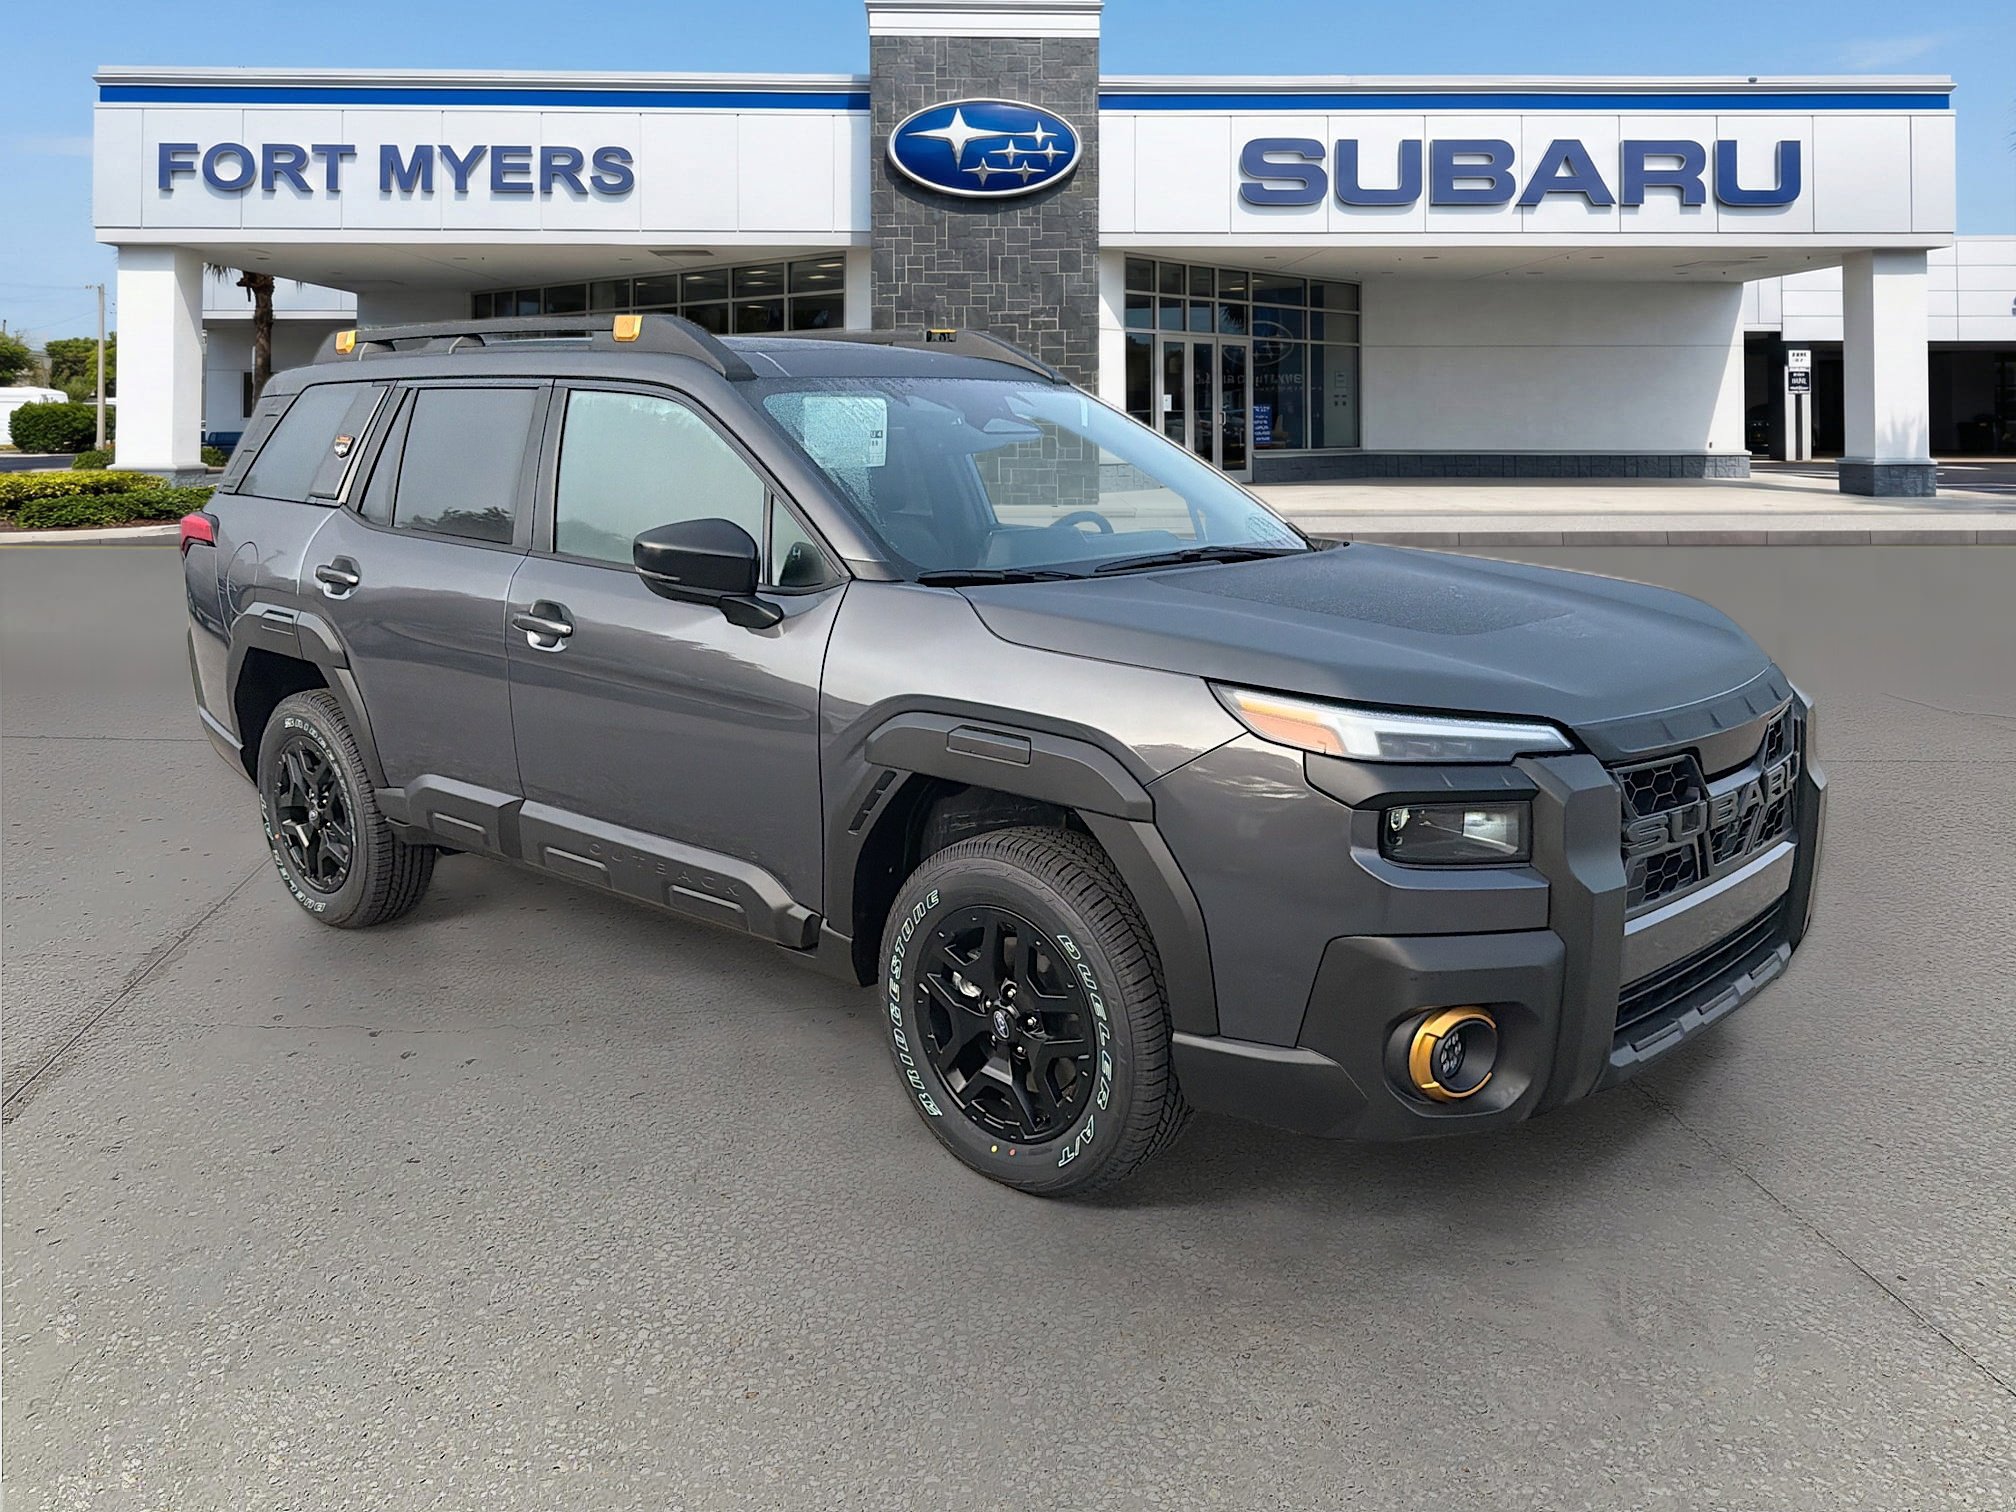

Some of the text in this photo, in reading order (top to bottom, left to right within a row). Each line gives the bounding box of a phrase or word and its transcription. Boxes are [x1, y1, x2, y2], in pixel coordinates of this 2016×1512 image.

[158, 142, 635, 195] FORT MYERS
[1239, 137, 1802, 207] SUBARU
[1625, 750, 1801, 852] SUBARU
[588, 842, 740, 898] OUTBACK
[888, 888, 943, 1118] BRIDGESTONE
[1057, 934, 1114, 1168] DUELER A/T
